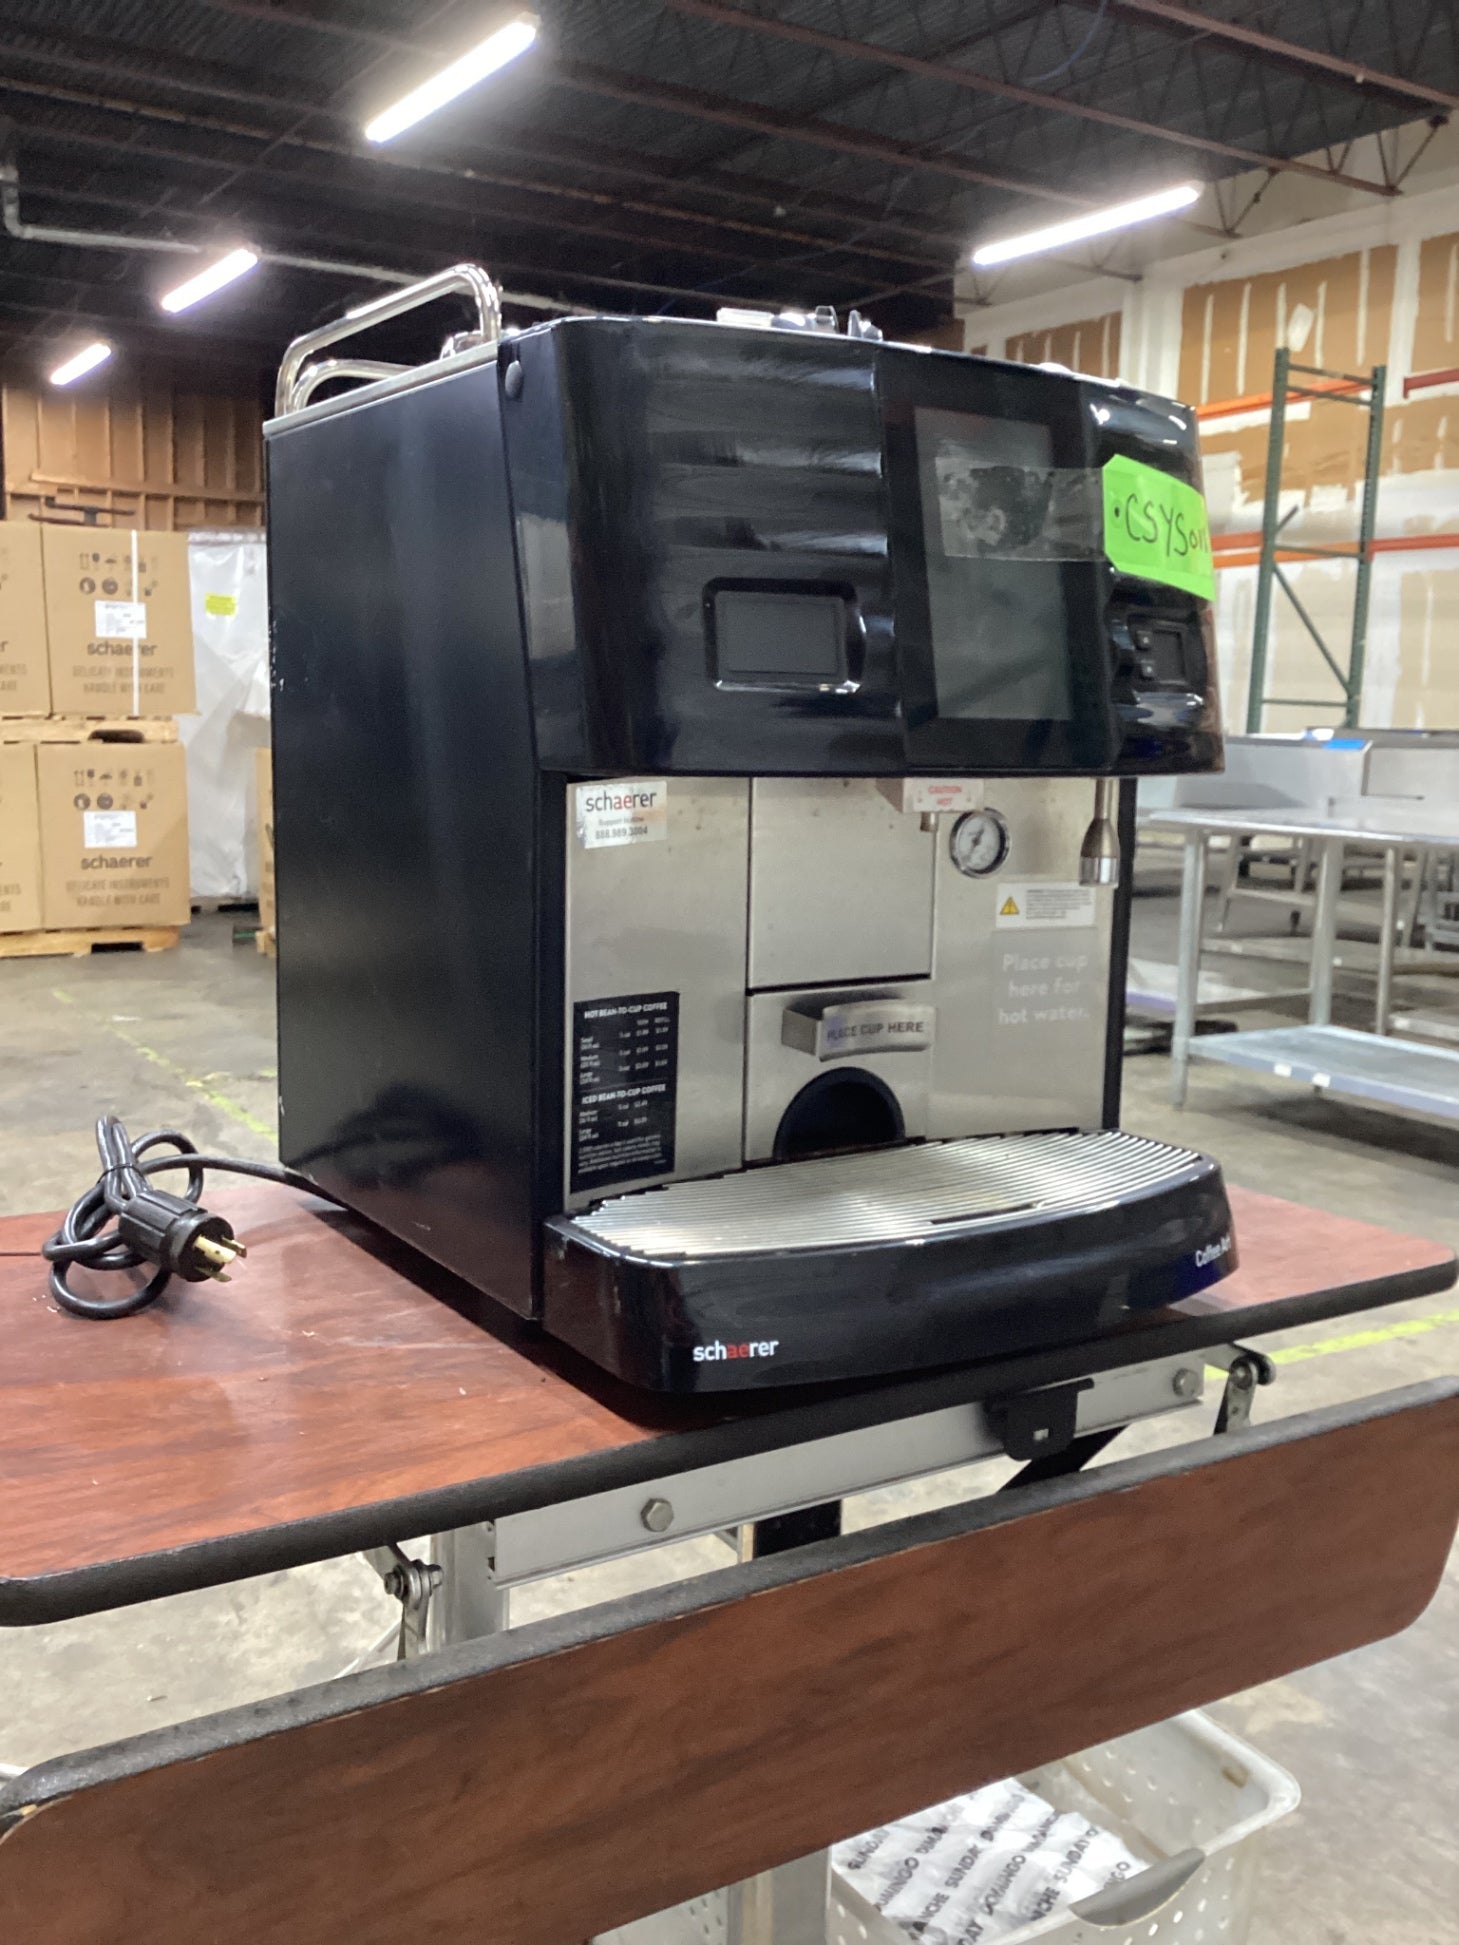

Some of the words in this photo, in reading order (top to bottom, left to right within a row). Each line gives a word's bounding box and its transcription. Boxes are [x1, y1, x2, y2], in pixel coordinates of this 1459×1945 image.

[585, 790, 657, 812] schaerer
[81, 855, 153, 870] schaerer
[1002, 953, 1050, 972] Place
[1055, 955, 1088, 973] cup
[1008, 979, 1049, 998] here
[1053, 976, 1081, 994] for
[643, 1002, 668, 1012] COFFEE
[998, 1007, 1027, 1025] hot
[860, 1023, 884, 1035] CUP
[887, 1021, 924, 1034] HERE
[581, 1094, 598, 1105] ICED
[641, 1083, 666, 1095] COFFEE
[692, 1340, 779, 1362] schaerer
